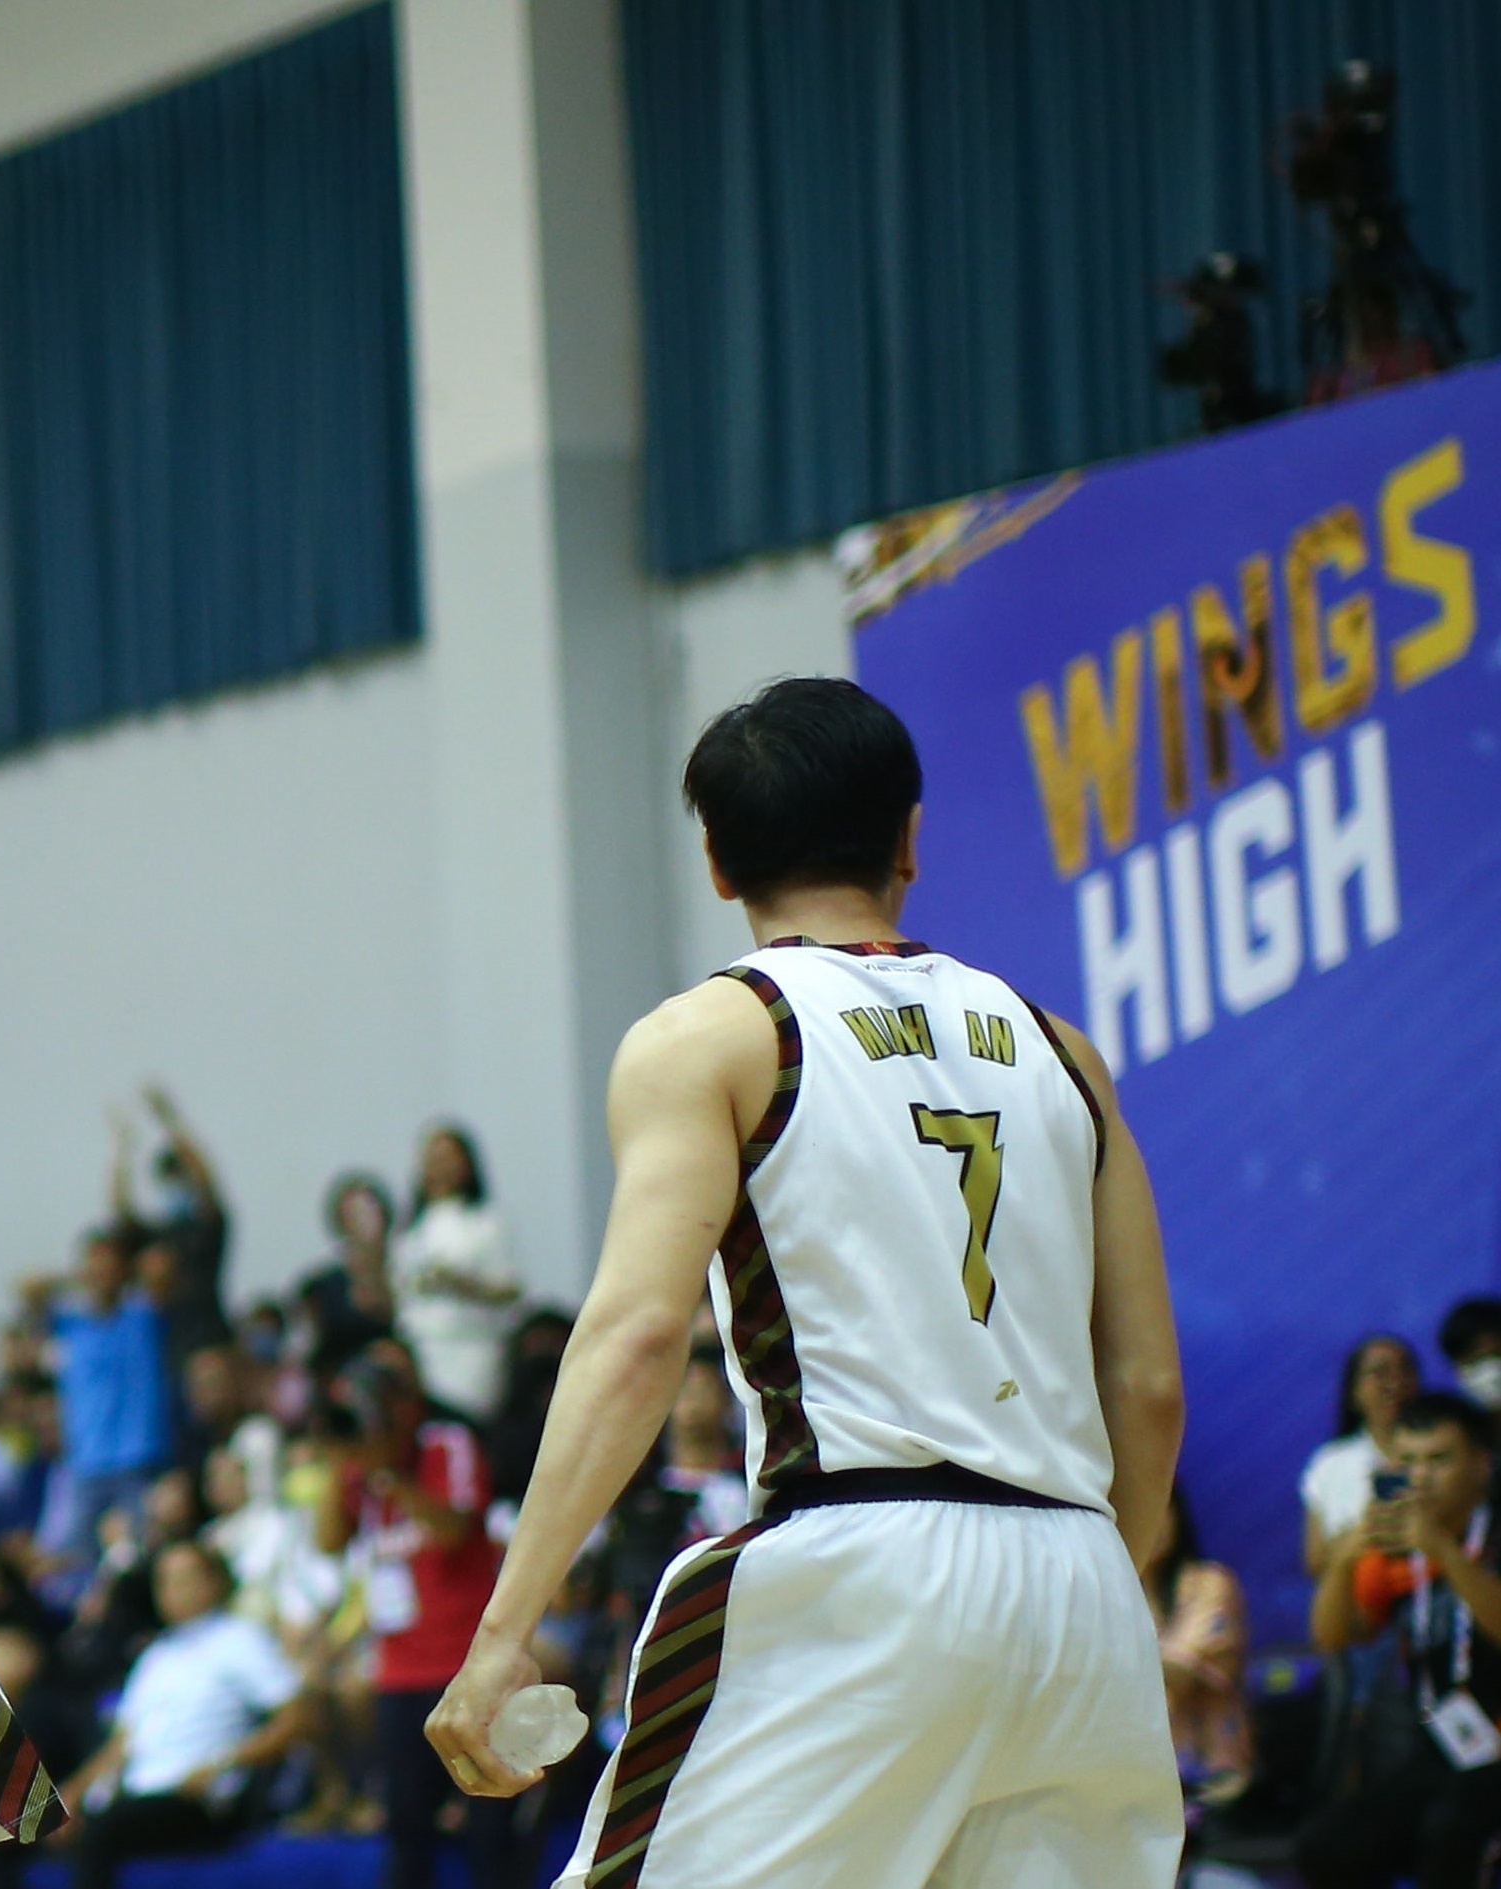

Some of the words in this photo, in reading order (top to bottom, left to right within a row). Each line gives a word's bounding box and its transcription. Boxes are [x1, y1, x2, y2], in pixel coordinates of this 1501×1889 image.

[1021, 436, 1477, 879] WINGS
[964, 1009, 1016, 1067] AN
[1077, 718, 1401, 1082] HIGH
[909, 1102, 1005, 1326] 7
